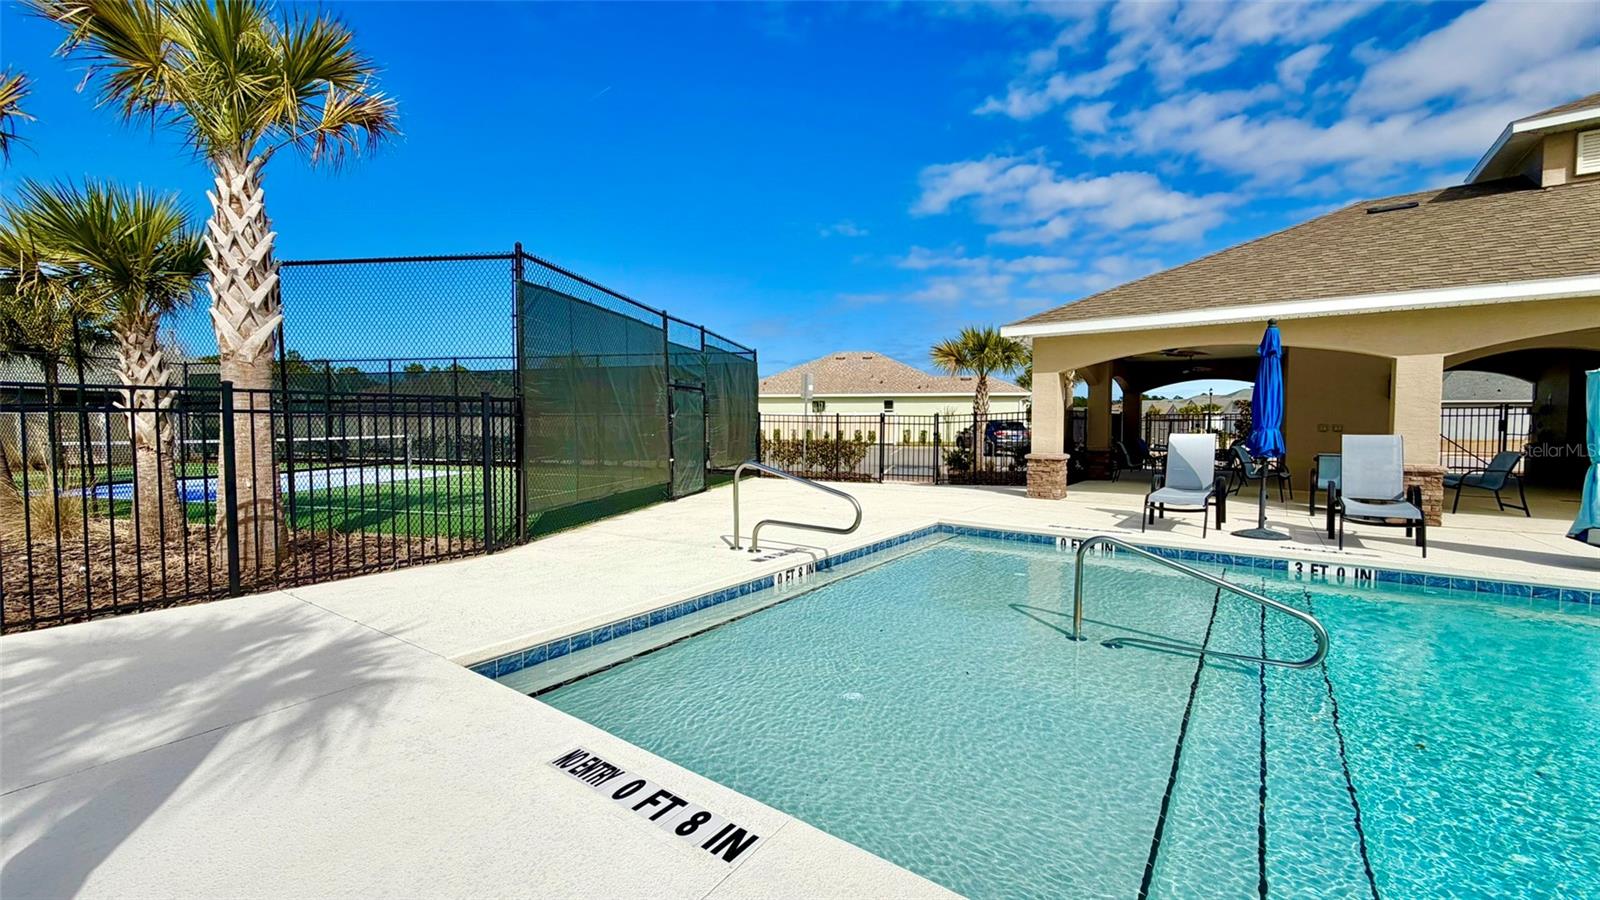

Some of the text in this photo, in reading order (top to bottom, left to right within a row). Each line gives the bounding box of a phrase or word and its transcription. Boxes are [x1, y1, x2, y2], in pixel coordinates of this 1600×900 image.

[1101, 542, 1113, 552] IN
[785, 569, 795, 582] FT
[806, 562, 814, 575] IN
[1295, 562, 1303, 574] 3
[1311, 563, 1328, 575] FT
[1354, 568, 1372, 580] IN
[552, 748, 590, 769] NO
[568, 757, 625, 787] ENTRY
[631, 789, 689, 821] FT
[675, 811, 712, 836] 8
[701, 823, 759, 863] IN
